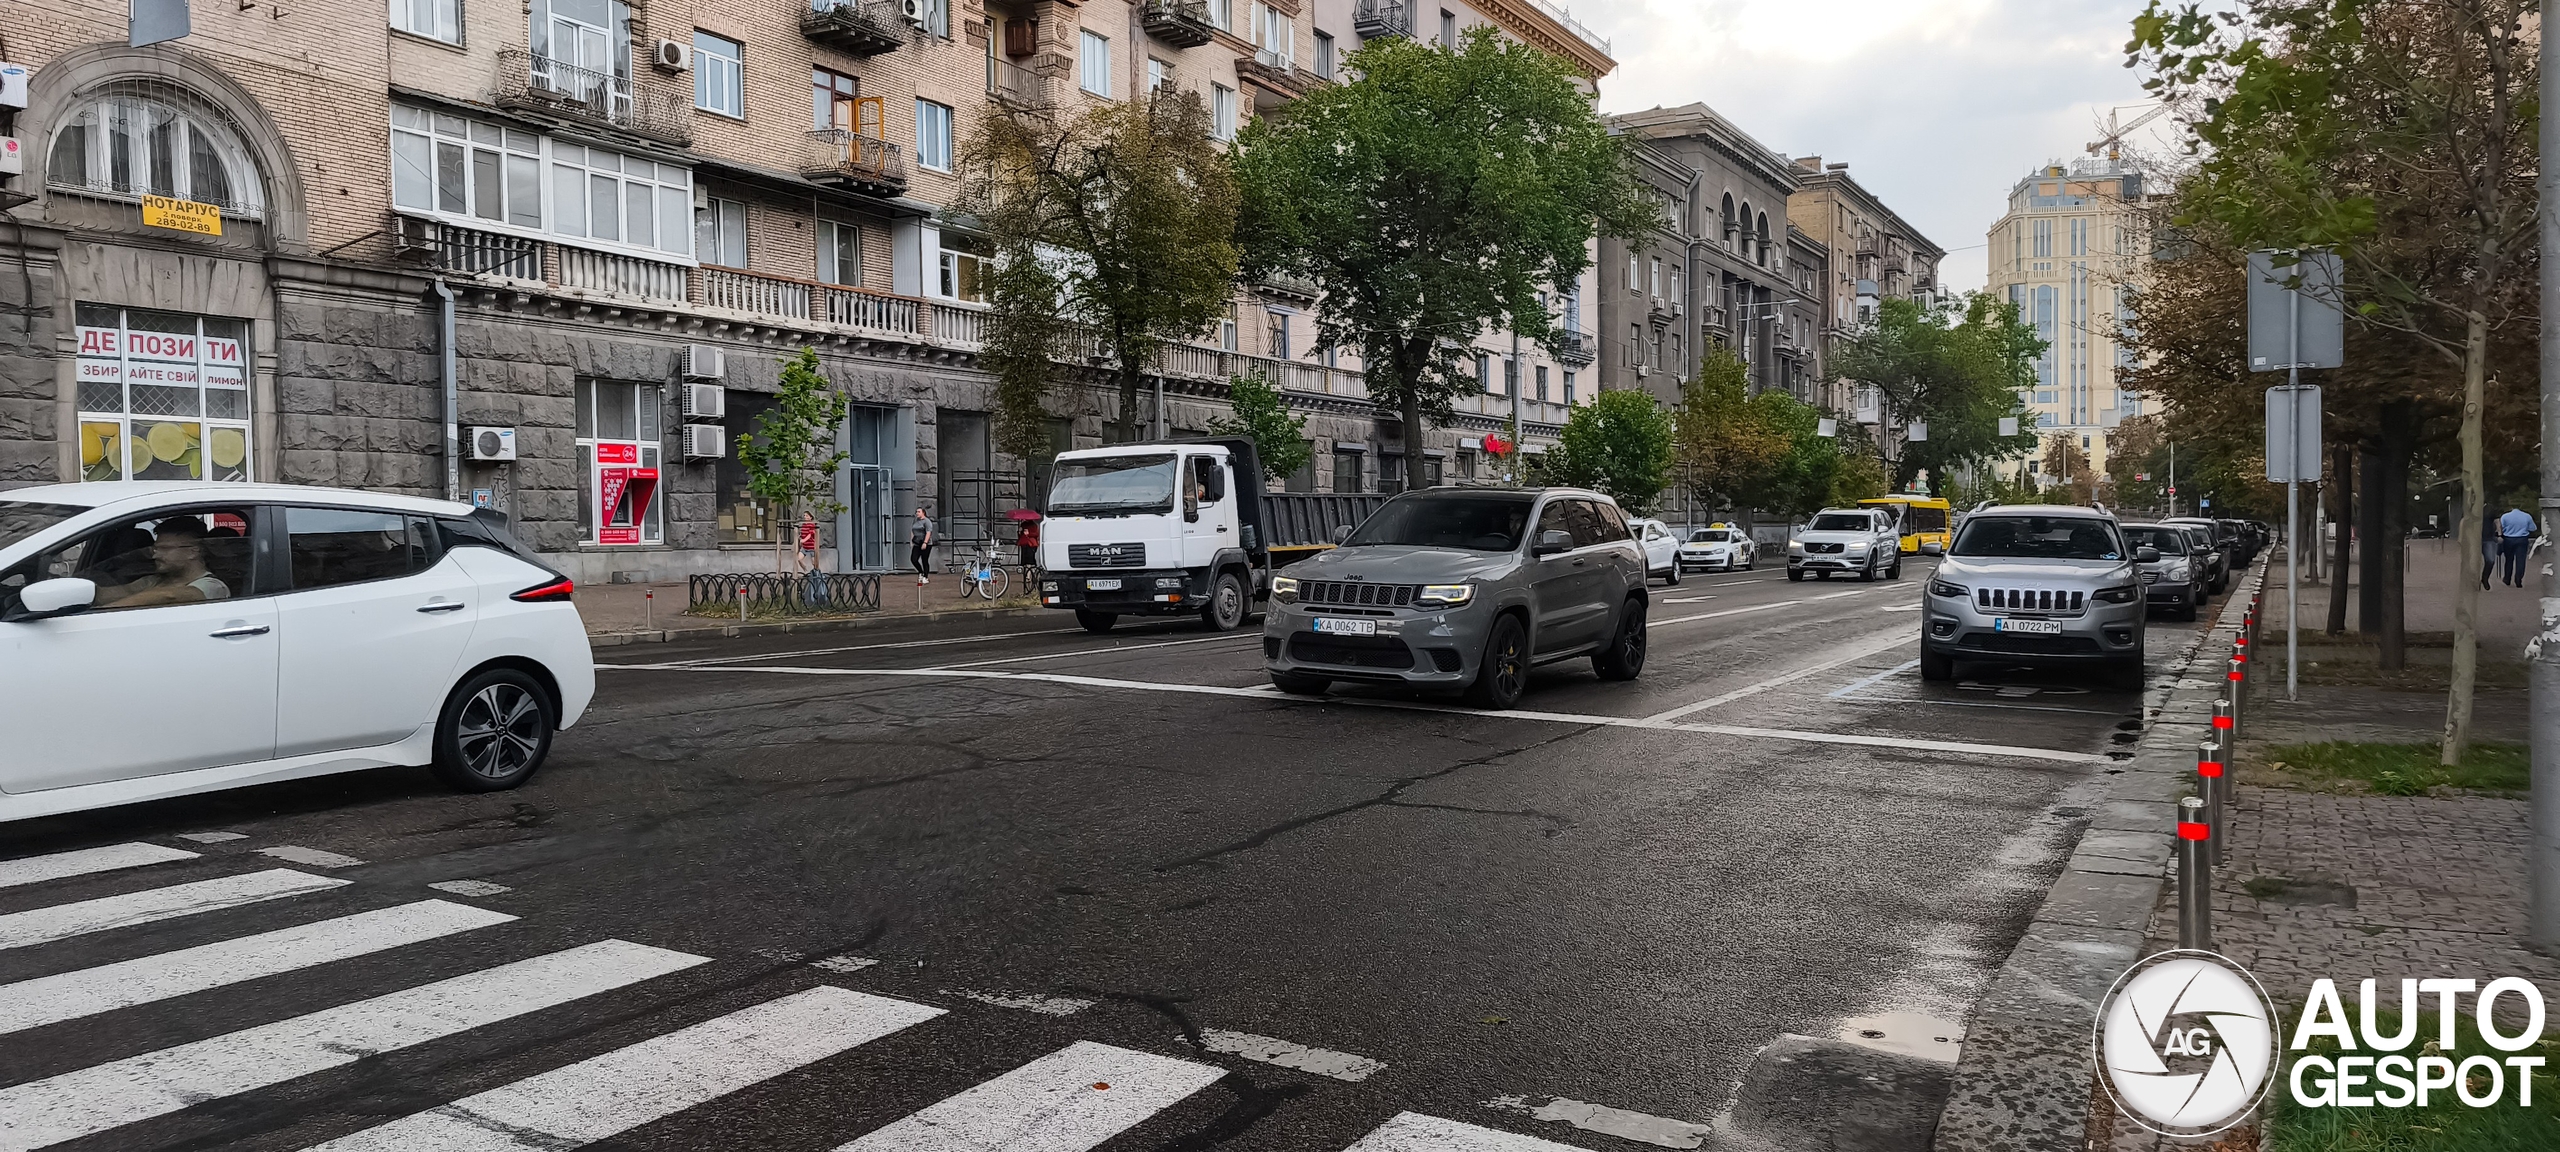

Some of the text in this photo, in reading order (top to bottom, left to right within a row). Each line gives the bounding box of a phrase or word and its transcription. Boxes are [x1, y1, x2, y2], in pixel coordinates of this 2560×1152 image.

[143, 195, 218, 218] НОТАРІУС
[171, 213, 202, 222] поверх
[156, 217, 211, 232] 289-02-89
[167, 370, 197, 383] СВІЙ
[624, 450, 633, 458] 24
[1089, 547, 1122, 556] MAN
[1343, 573, 1364, 581] Jeep
[1319, 619, 1374, 633] KA 0062 TB
[2002, 621, 2059, 632] AI 0722 PM
